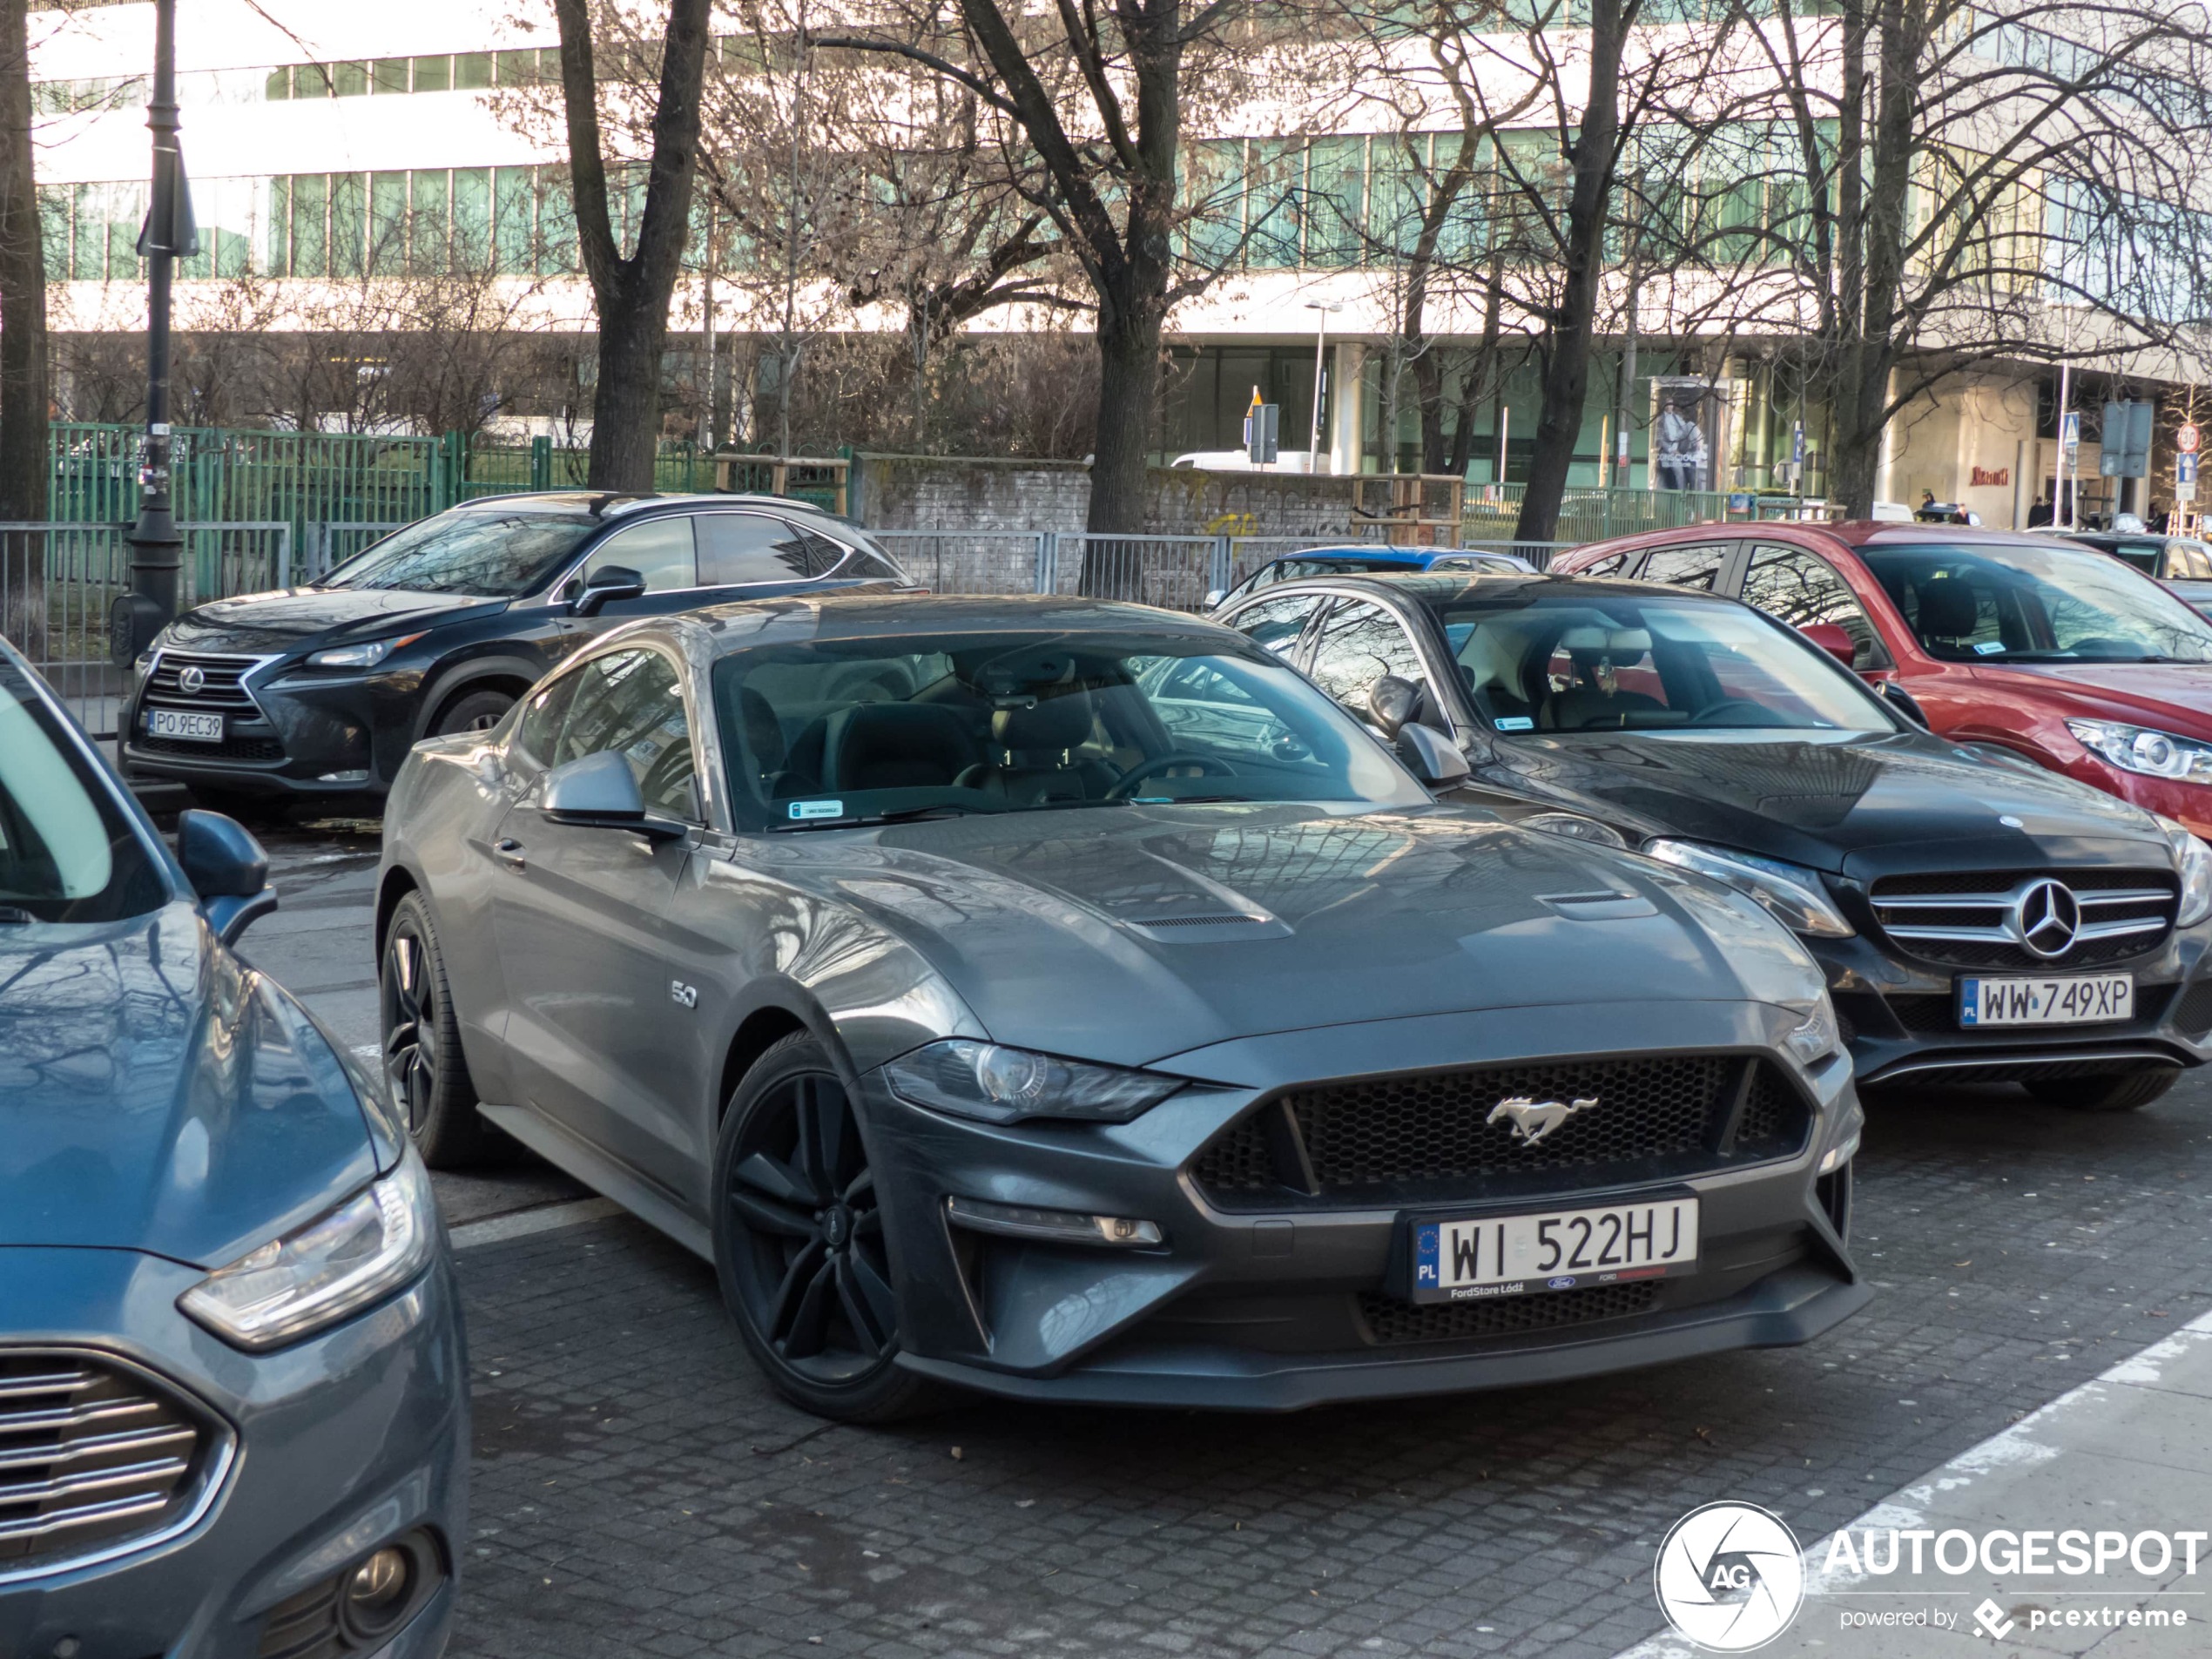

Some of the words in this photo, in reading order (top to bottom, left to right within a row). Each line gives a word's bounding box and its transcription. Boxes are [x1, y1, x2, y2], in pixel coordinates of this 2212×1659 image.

[2182, 431, 2195, 445] 30
[157, 712, 177, 733] PO
[179, 715, 222, 737] 9EC39
[1984, 984, 2032, 1020] WW
[2042, 980, 2128, 1018] 749XP
[1964, 1007, 1976, 1017] PL
[1451, 1223, 1506, 1282] WI
[1536, 1205, 1681, 1272] 522HJ
[1418, 1264, 1437, 1280] PL
[1550, 1278, 1574, 1288] Ford
[1451, 1285, 1500, 1298] FordStore
